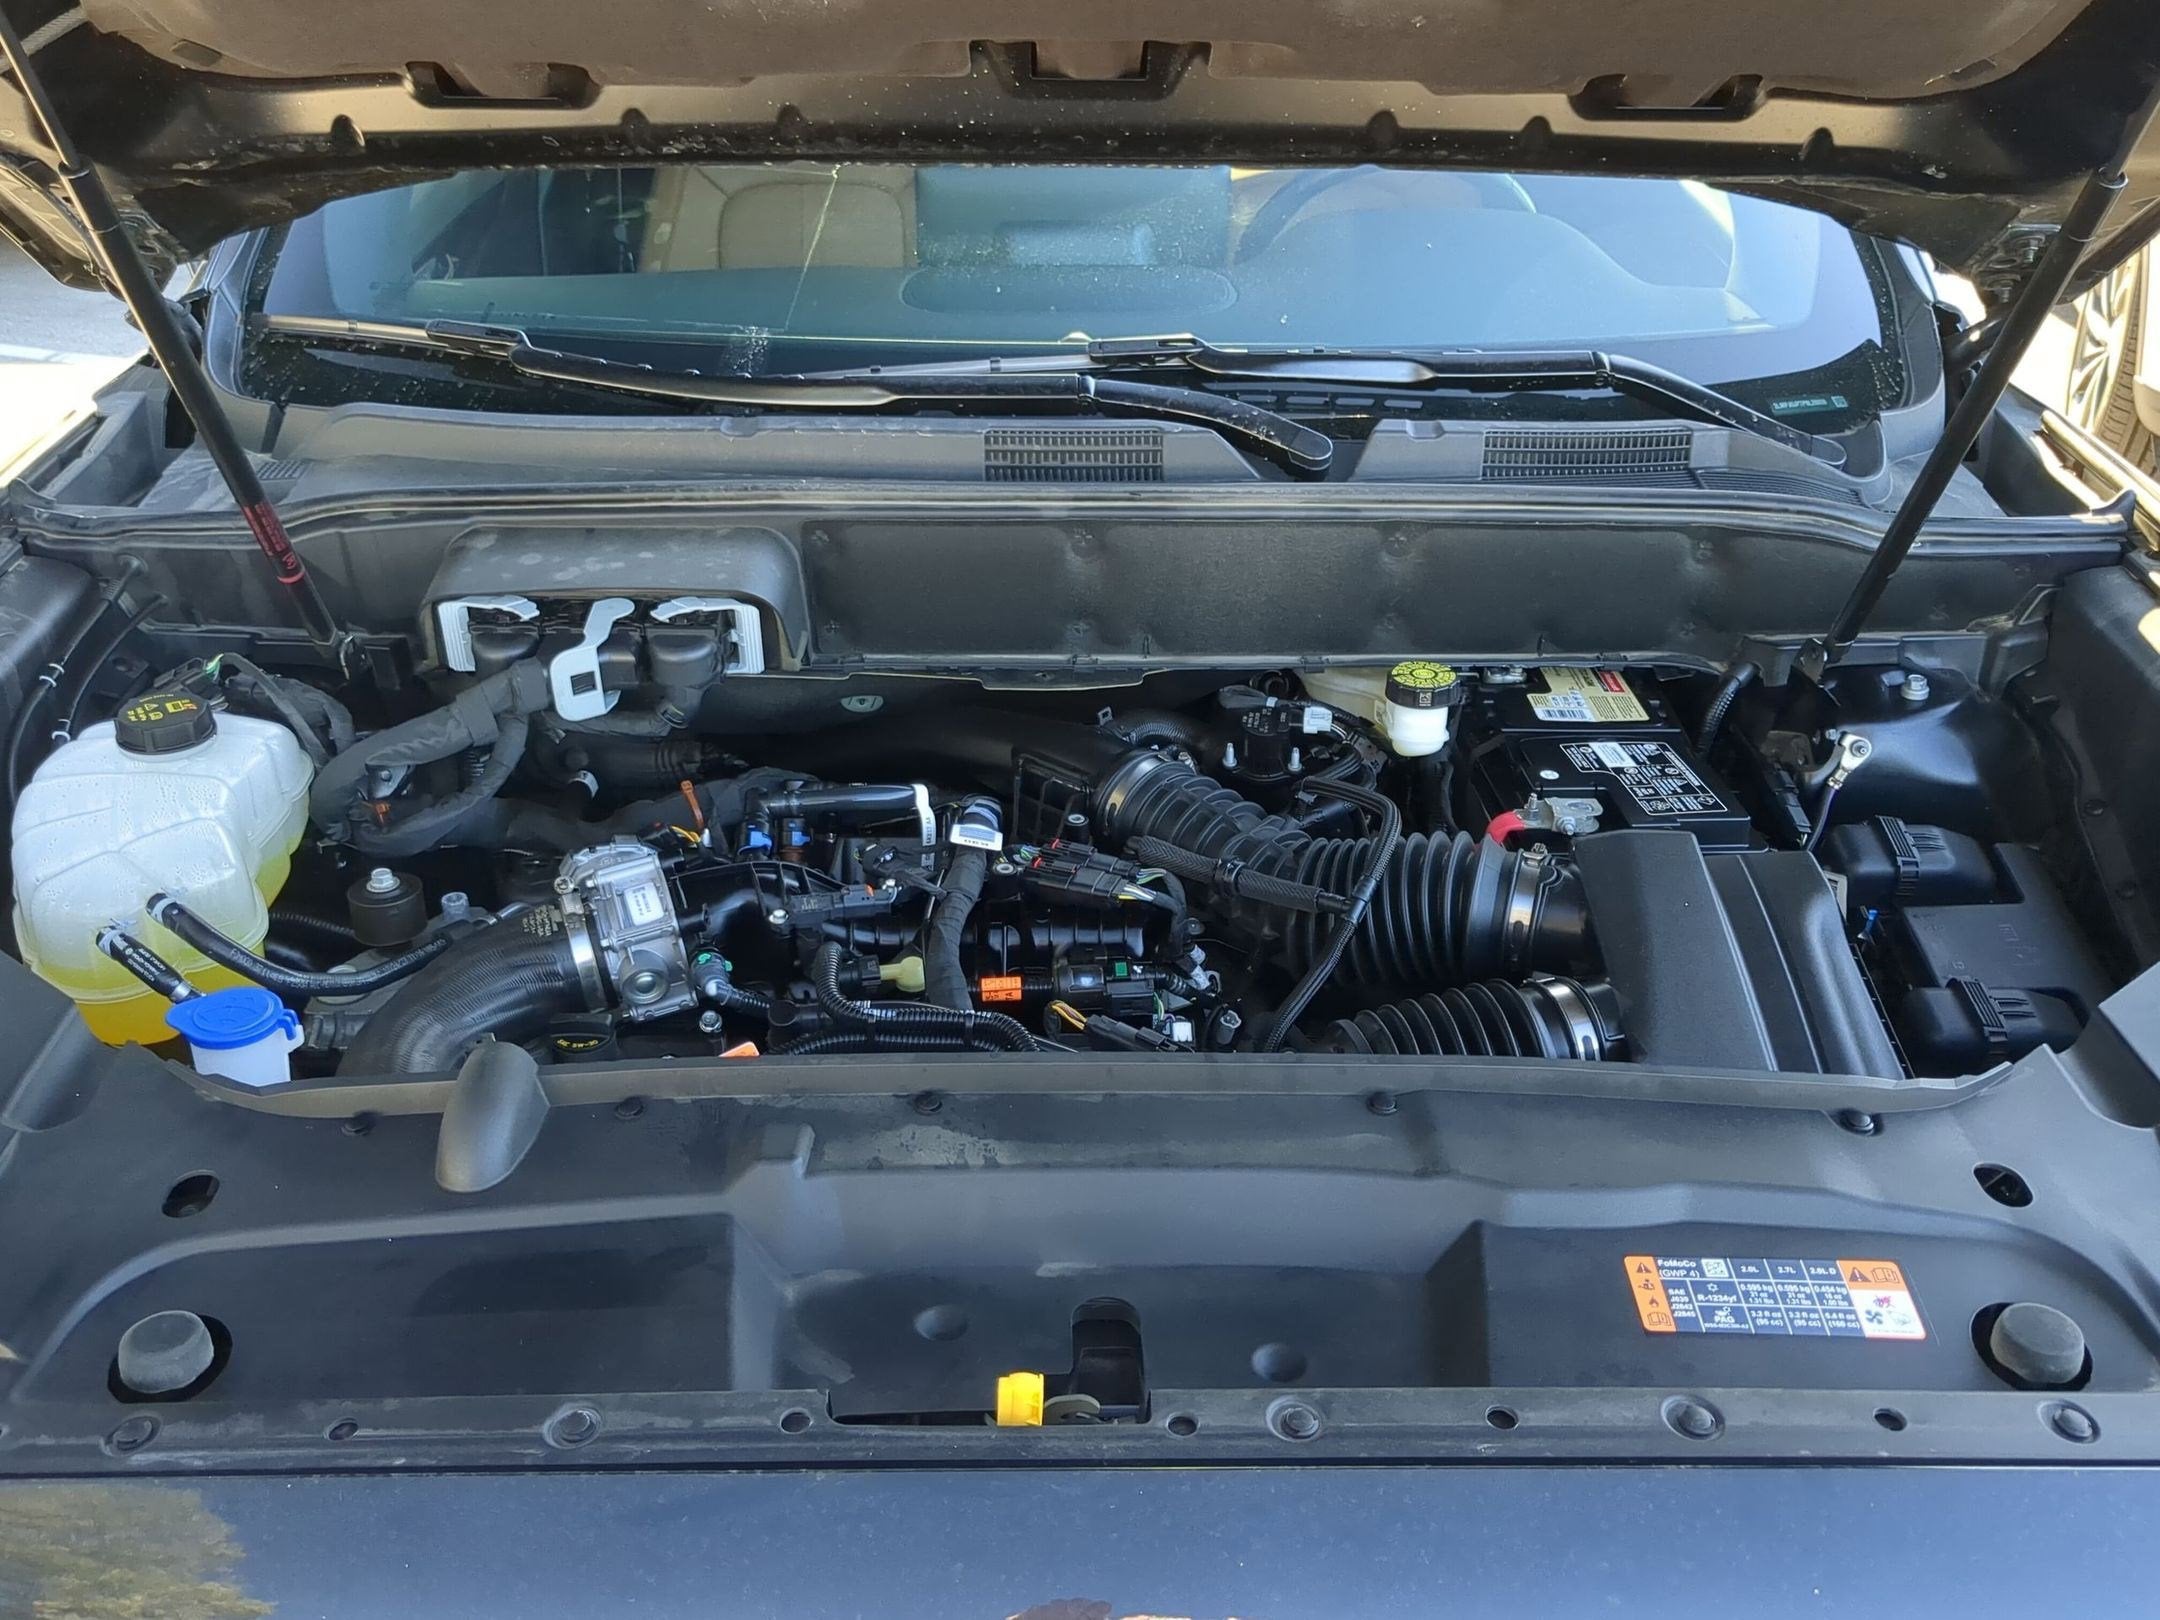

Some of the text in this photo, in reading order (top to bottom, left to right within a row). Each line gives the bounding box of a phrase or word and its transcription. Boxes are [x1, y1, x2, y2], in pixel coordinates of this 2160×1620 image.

[1657, 1259, 1697, 1267] FoMoCo
[1659, 1269, 1700, 1279] (GWP 4)
[1777, 1266, 1797, 1274] 2.7L
[1696, 1293, 1738, 1303] R-1234yf
[1714, 1315, 1735, 1323] PAG
